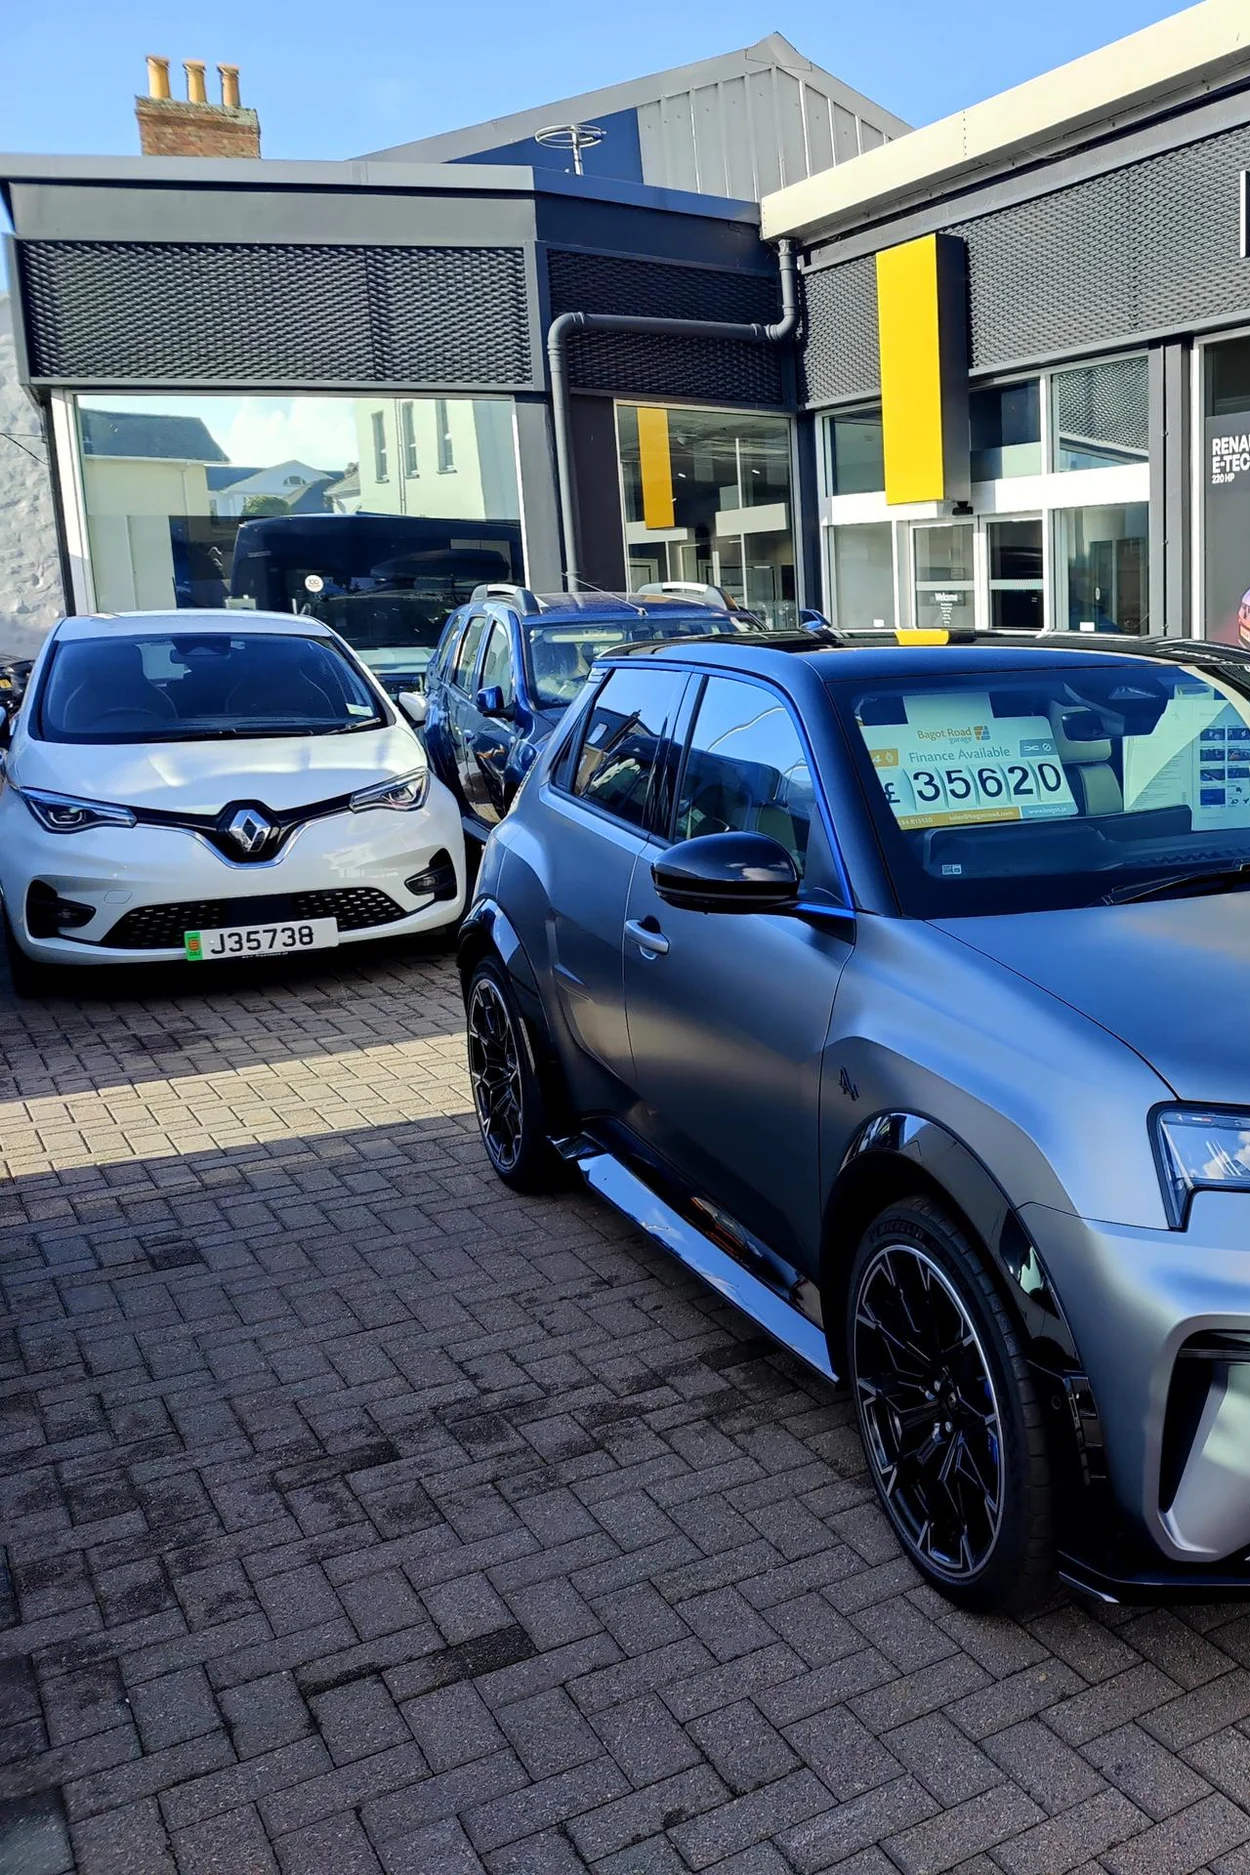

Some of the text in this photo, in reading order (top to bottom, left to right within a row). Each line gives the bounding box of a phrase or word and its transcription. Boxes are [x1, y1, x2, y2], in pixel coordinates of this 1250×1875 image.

[1211, 472, 1235, 484] 220 HP
[916, 726, 973, 741] Bagot Road
[948, 734, 973, 745] garage
[908, 746, 1011, 764] Finance Available
[912, 762, 1062, 802] 35620
[210, 925, 315, 955] J35738
